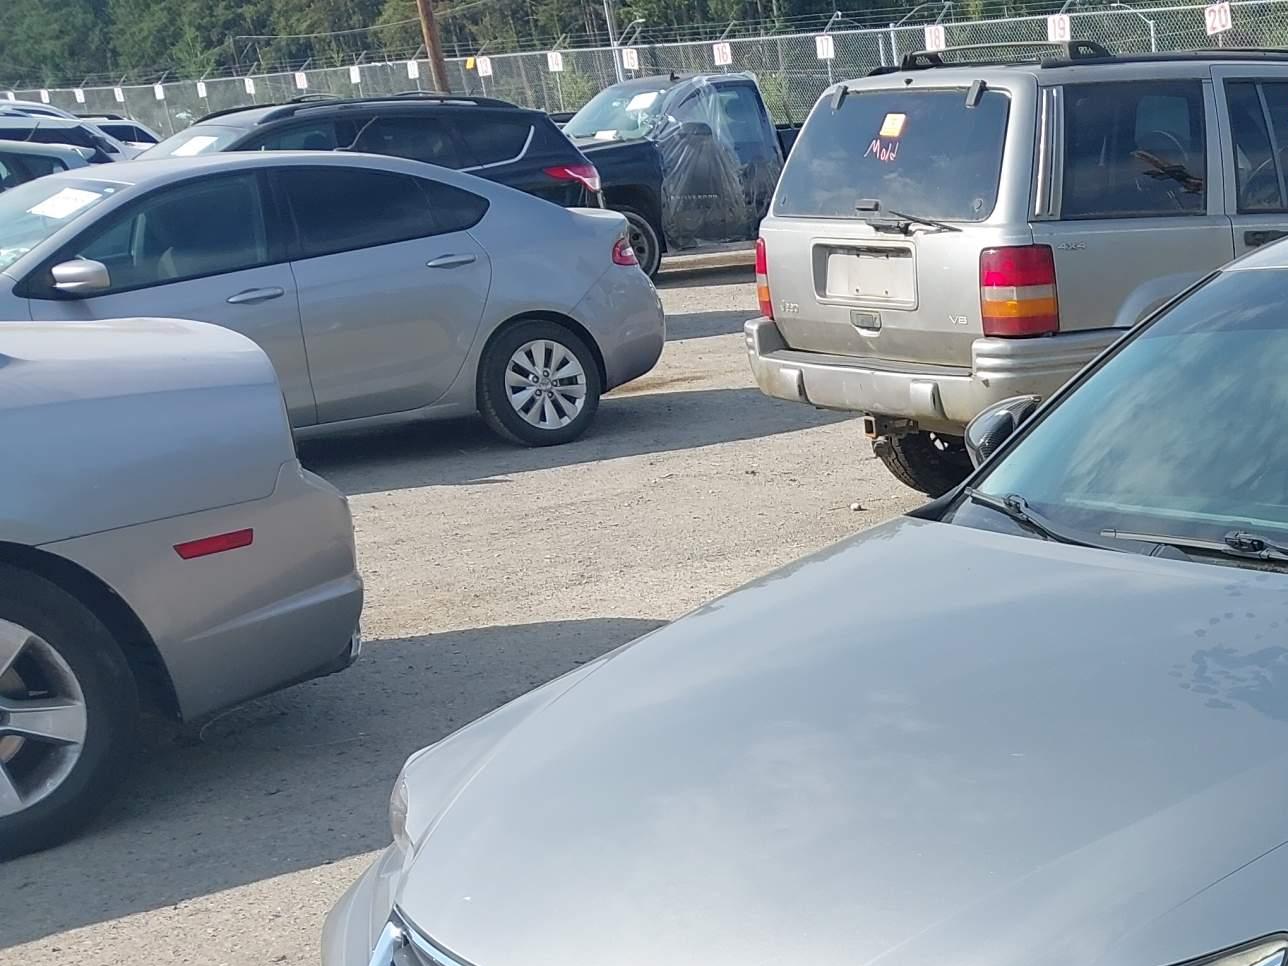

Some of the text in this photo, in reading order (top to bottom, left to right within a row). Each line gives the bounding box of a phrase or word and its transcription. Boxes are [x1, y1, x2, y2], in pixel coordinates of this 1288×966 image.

[1052, 17, 1066, 39] 19
[1208, 5, 1228, 31] 20
[820, 37, 831, 57] 17
[930, 28, 941, 48] 18
[625, 49, 636, 67] 15
[716, 44, 729, 62] 16
[863, 138, 900, 161] Mold
